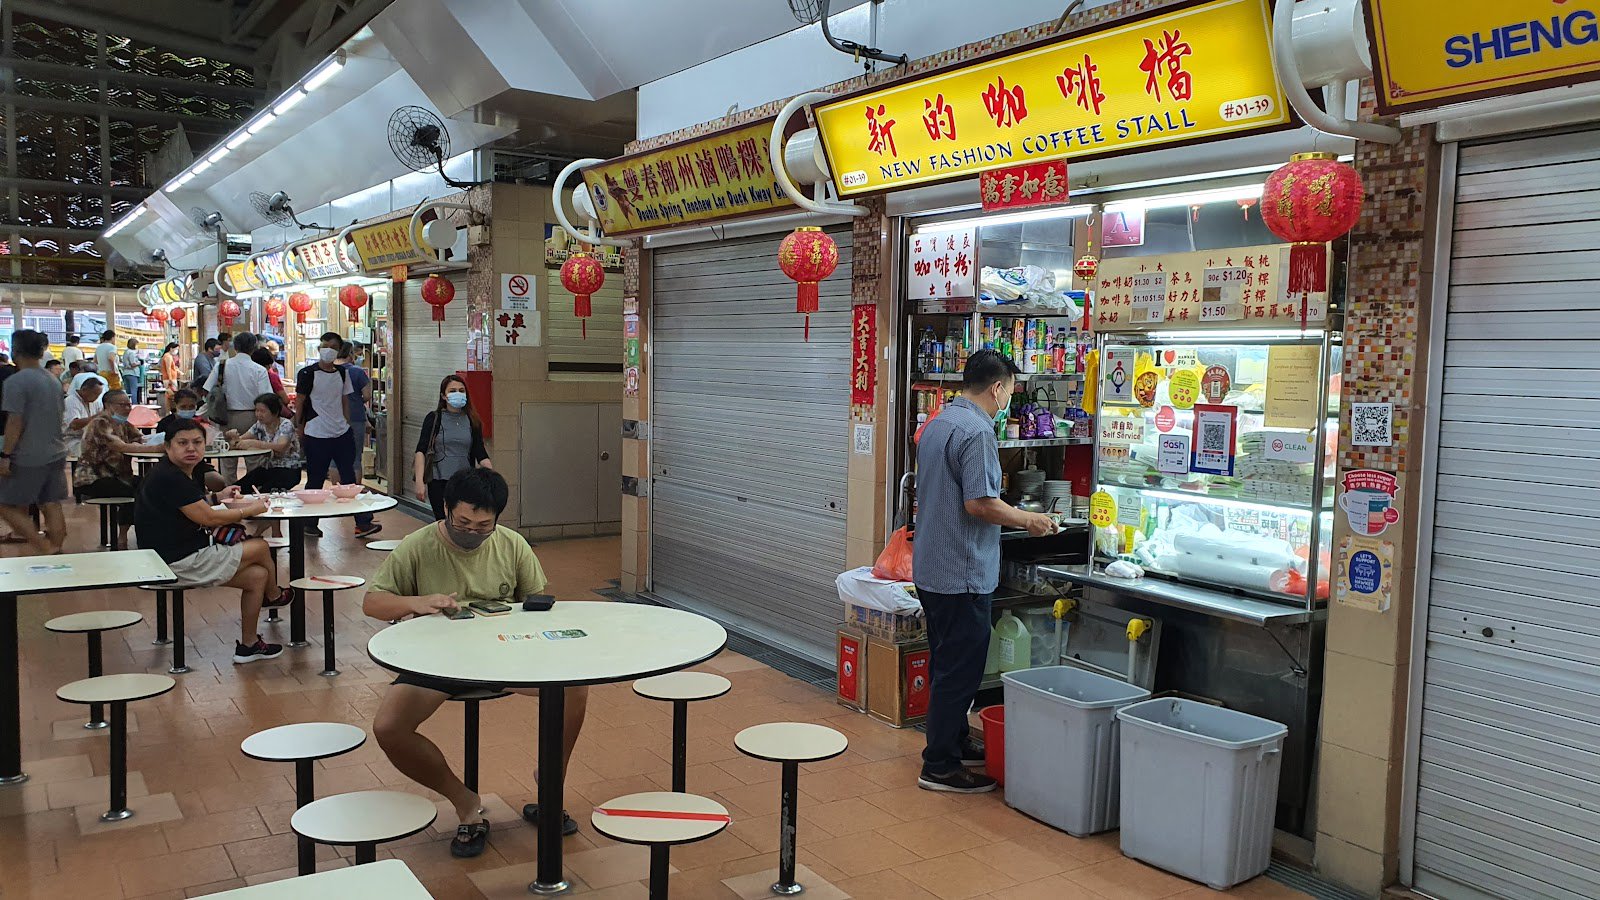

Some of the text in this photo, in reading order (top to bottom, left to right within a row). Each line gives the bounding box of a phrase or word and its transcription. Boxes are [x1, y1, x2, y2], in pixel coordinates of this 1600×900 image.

[1444, 10, 1599, 68] SHENG
[865, 29, 1192, 158] 新的咖啡檔
[1223, 98, 1270, 118] #01-39
[880, 108, 1196, 180] NEW FASHION COFFEE STALL
[621, 137, 772, 202] 雙春潮州滷鴨粿
[984, 166, 1064, 204] 萬事如意
[636, 204, 660, 222] Double
[659, 201, 684, 222] Spring
[712, 193, 727, 209] Lor
[726, 187, 749, 208] Duck
[748, 185, 773, 206] Kway
[914, 251, 971, 278] 咖啡粉
[1140, 262, 1163, 272] 小 大
[1206, 257, 1233, 267] 小 大
[1222, 269, 1247, 281] $1.20
[929, 280, 952, 296] 出售
[1101, 276, 1163, 289] 咖啡奶 $1.30 $2
[1133, 295, 1149, 303] $1.10
[1149, 294, 1165, 302] $1.50
[1168, 288, 1200, 303] 好力克
[1098, 311, 1119, 325] 茶奶
[1202, 306, 1226, 317] $1.50
[856, 310, 870, 392] 大吉大利
[1155, 350, 1162, 366] I
[1111, 420, 1134, 431] 请自助
[1102, 430, 1141, 440] Self Service
[1163, 440, 1185, 450] dash
[1284, 443, 1307, 451] CLEAN
[1377, 474, 1393, 482] sugar
